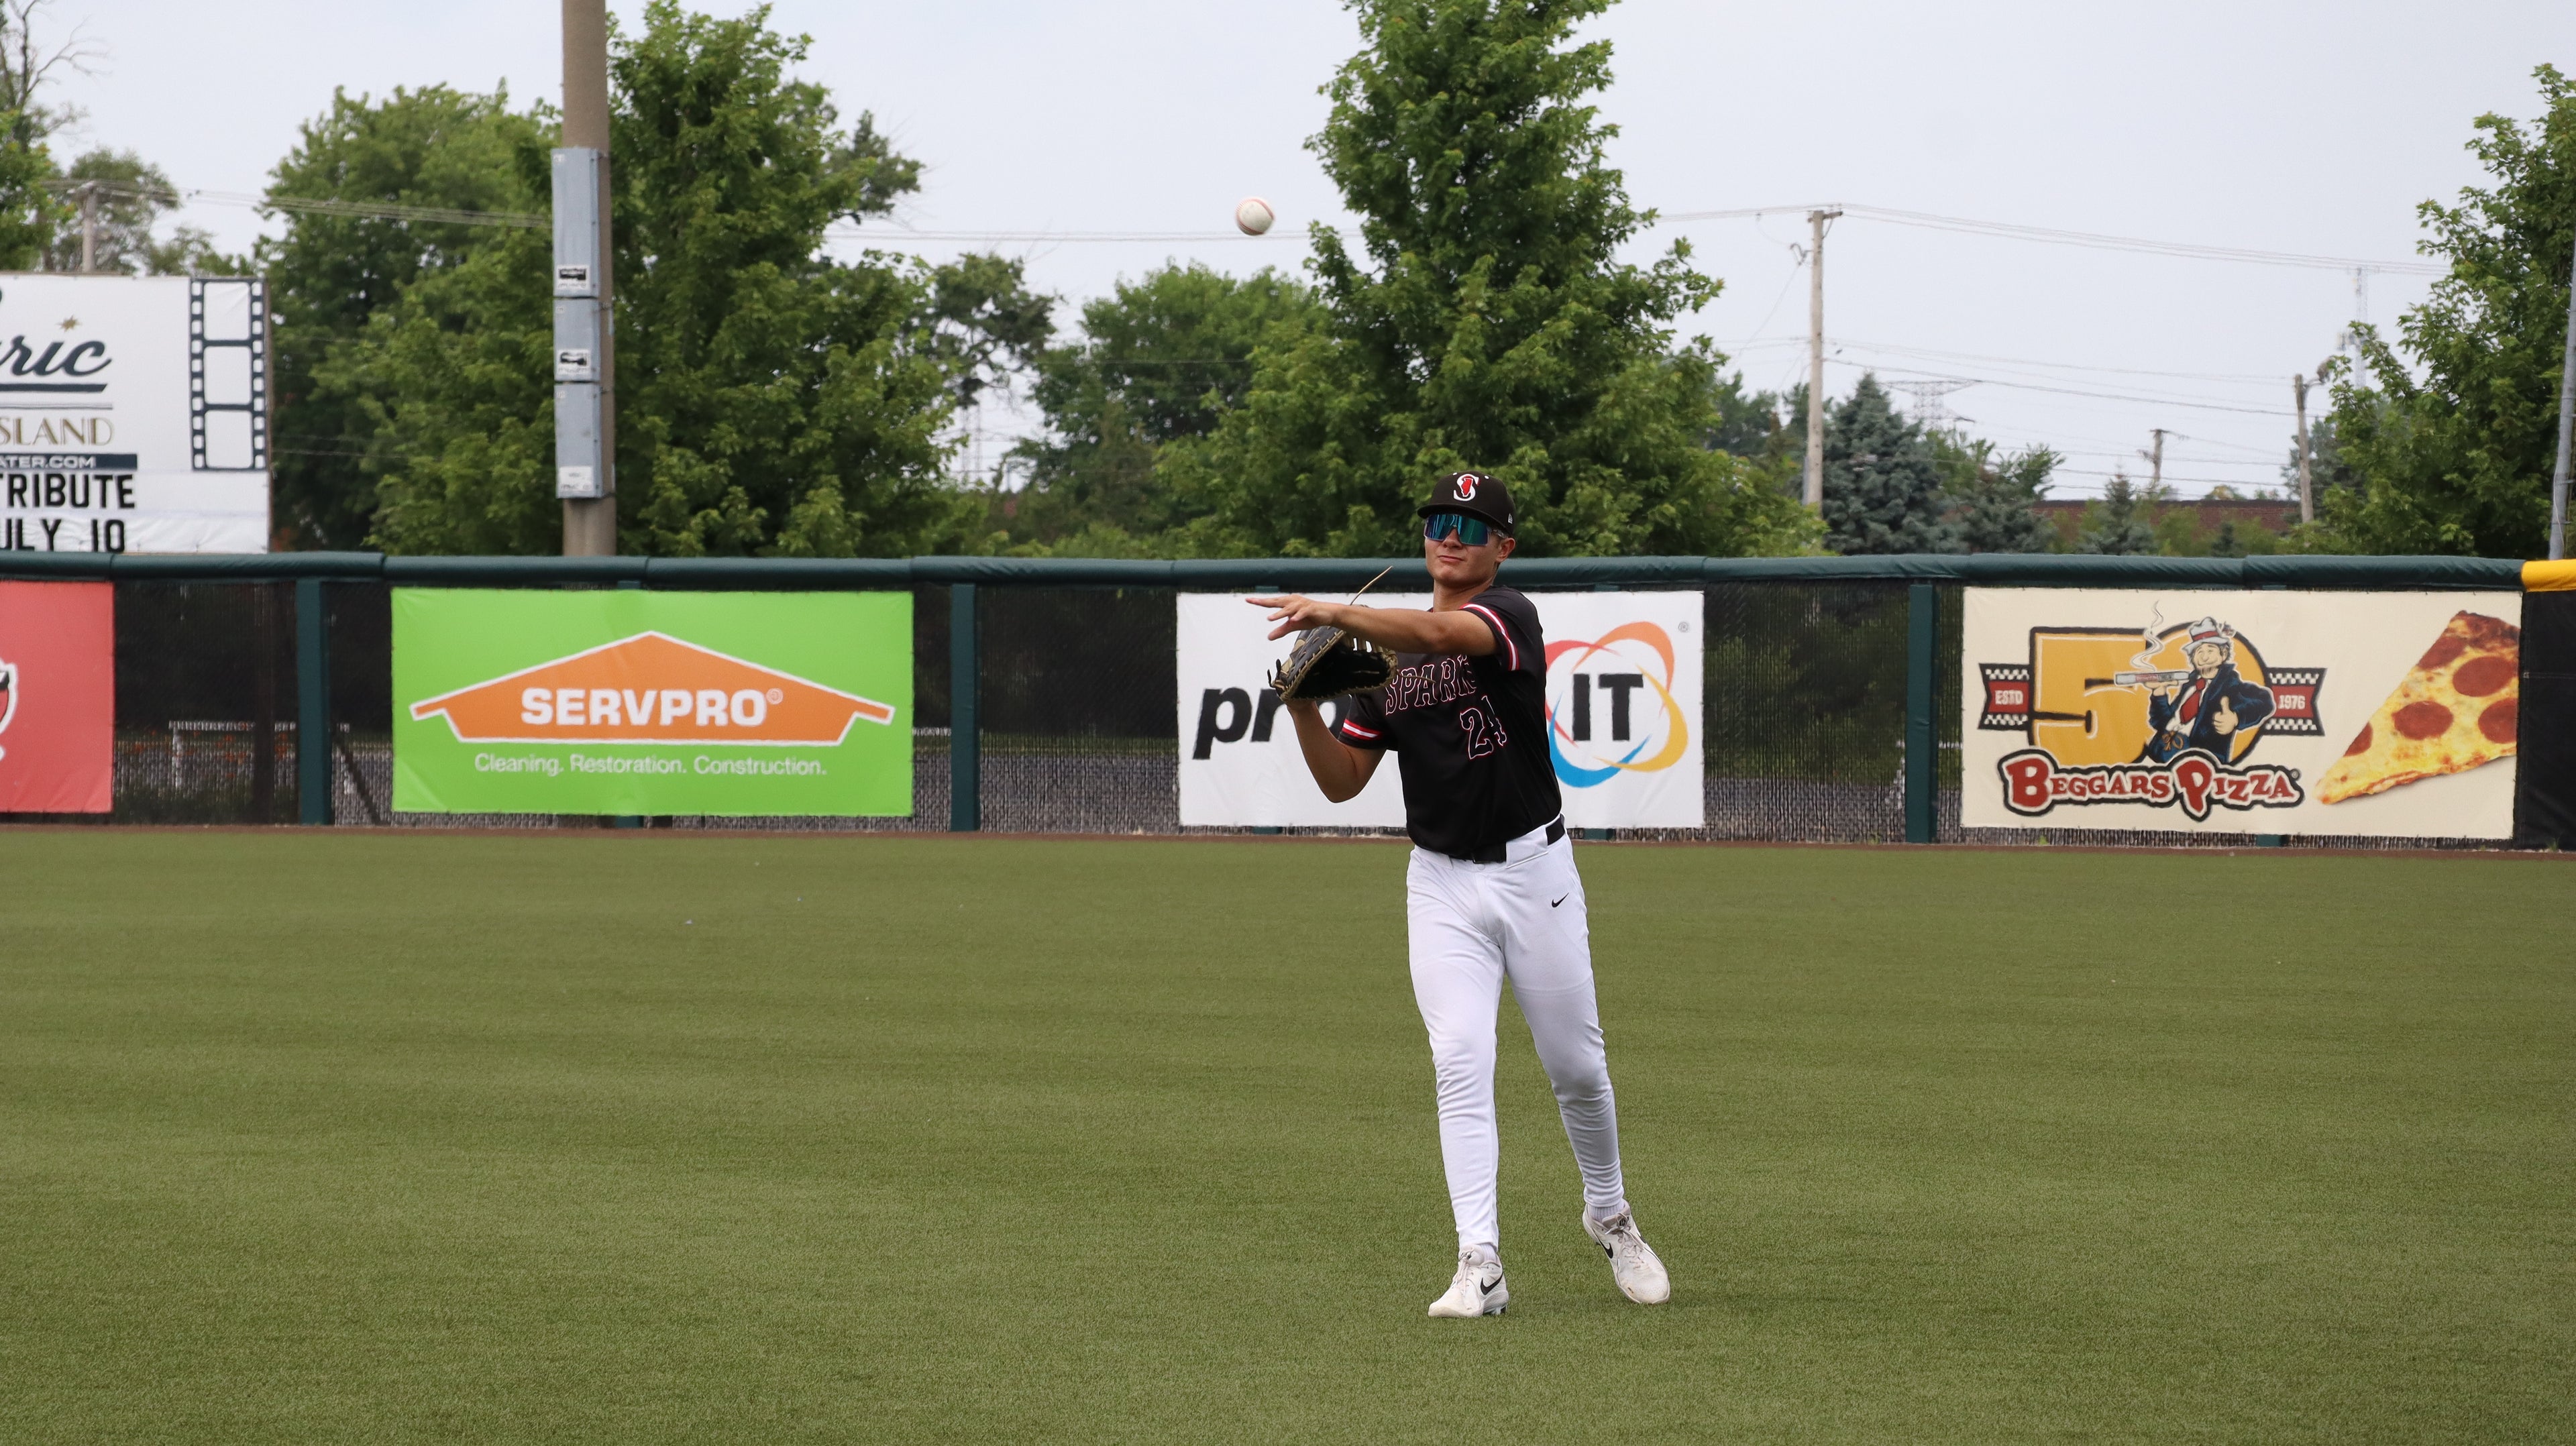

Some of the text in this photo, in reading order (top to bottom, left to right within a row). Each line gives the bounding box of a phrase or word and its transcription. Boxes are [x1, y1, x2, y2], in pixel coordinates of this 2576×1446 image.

[0, 334, 112, 376] ric
[0, 473, 136, 508] RIBUTE
[1572, 673, 1644, 741] IT
[1994, 689, 2306, 710] ESTD 1976
[474, 753, 827, 776] Cleaning. Restoration. Construction.
